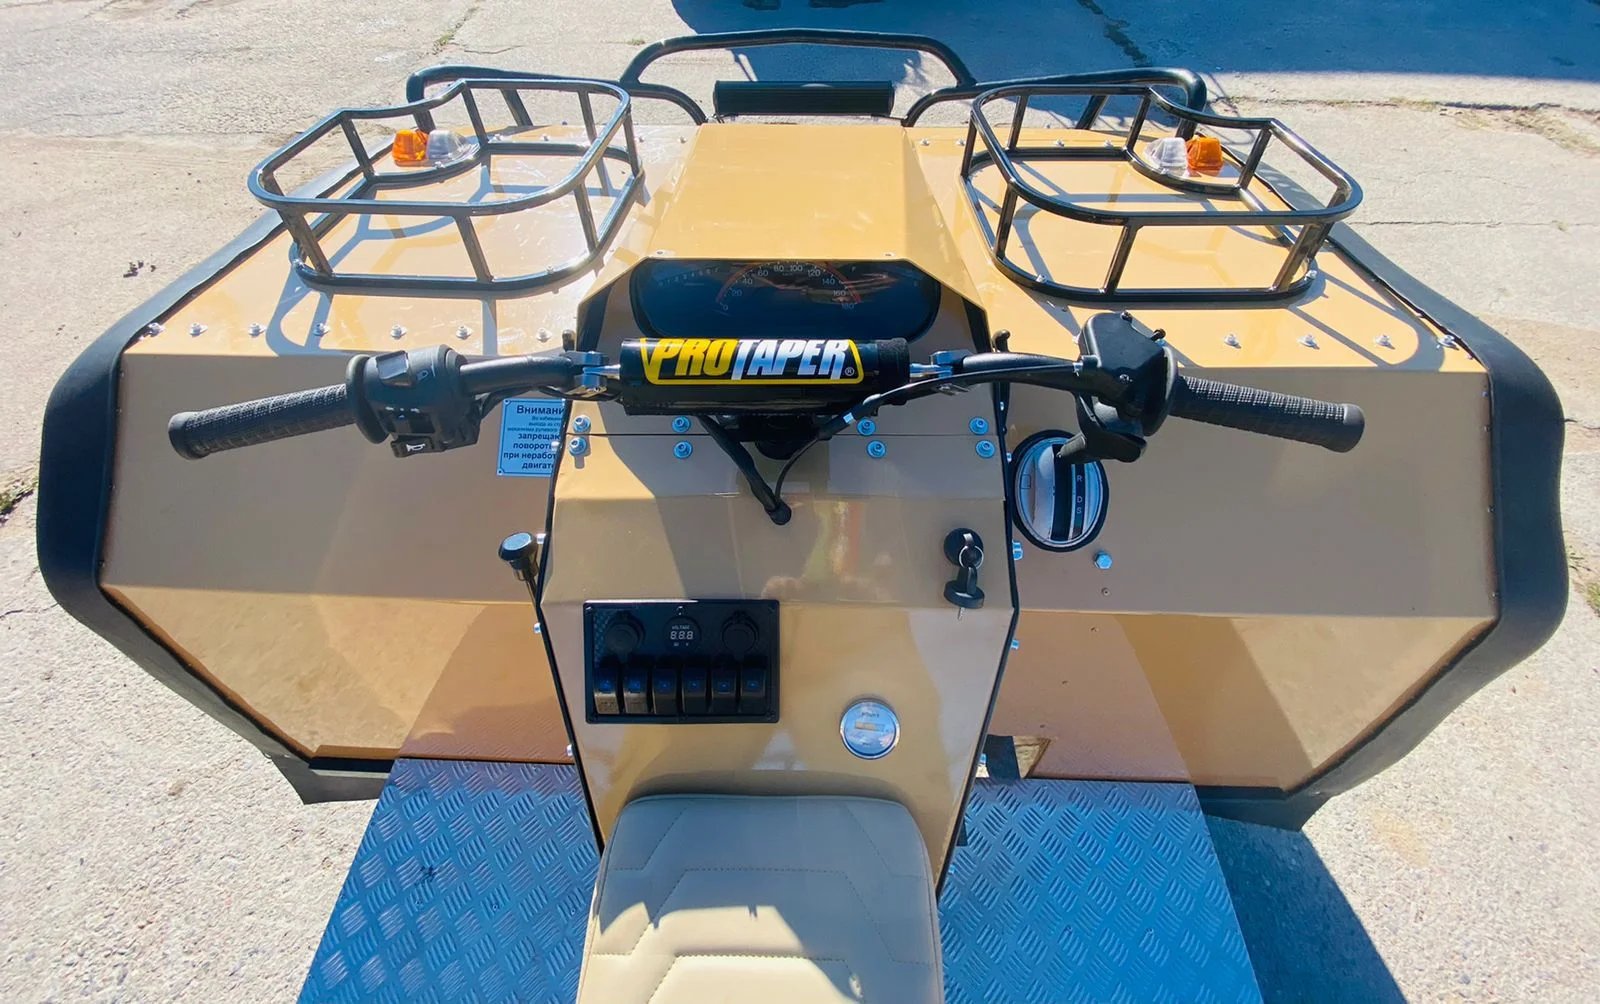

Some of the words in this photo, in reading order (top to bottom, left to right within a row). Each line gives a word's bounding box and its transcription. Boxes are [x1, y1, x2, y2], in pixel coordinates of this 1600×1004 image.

[503, 452, 520, 460] при
[1076, 474, 1083, 482] R
[1076, 495, 1083, 503] D
